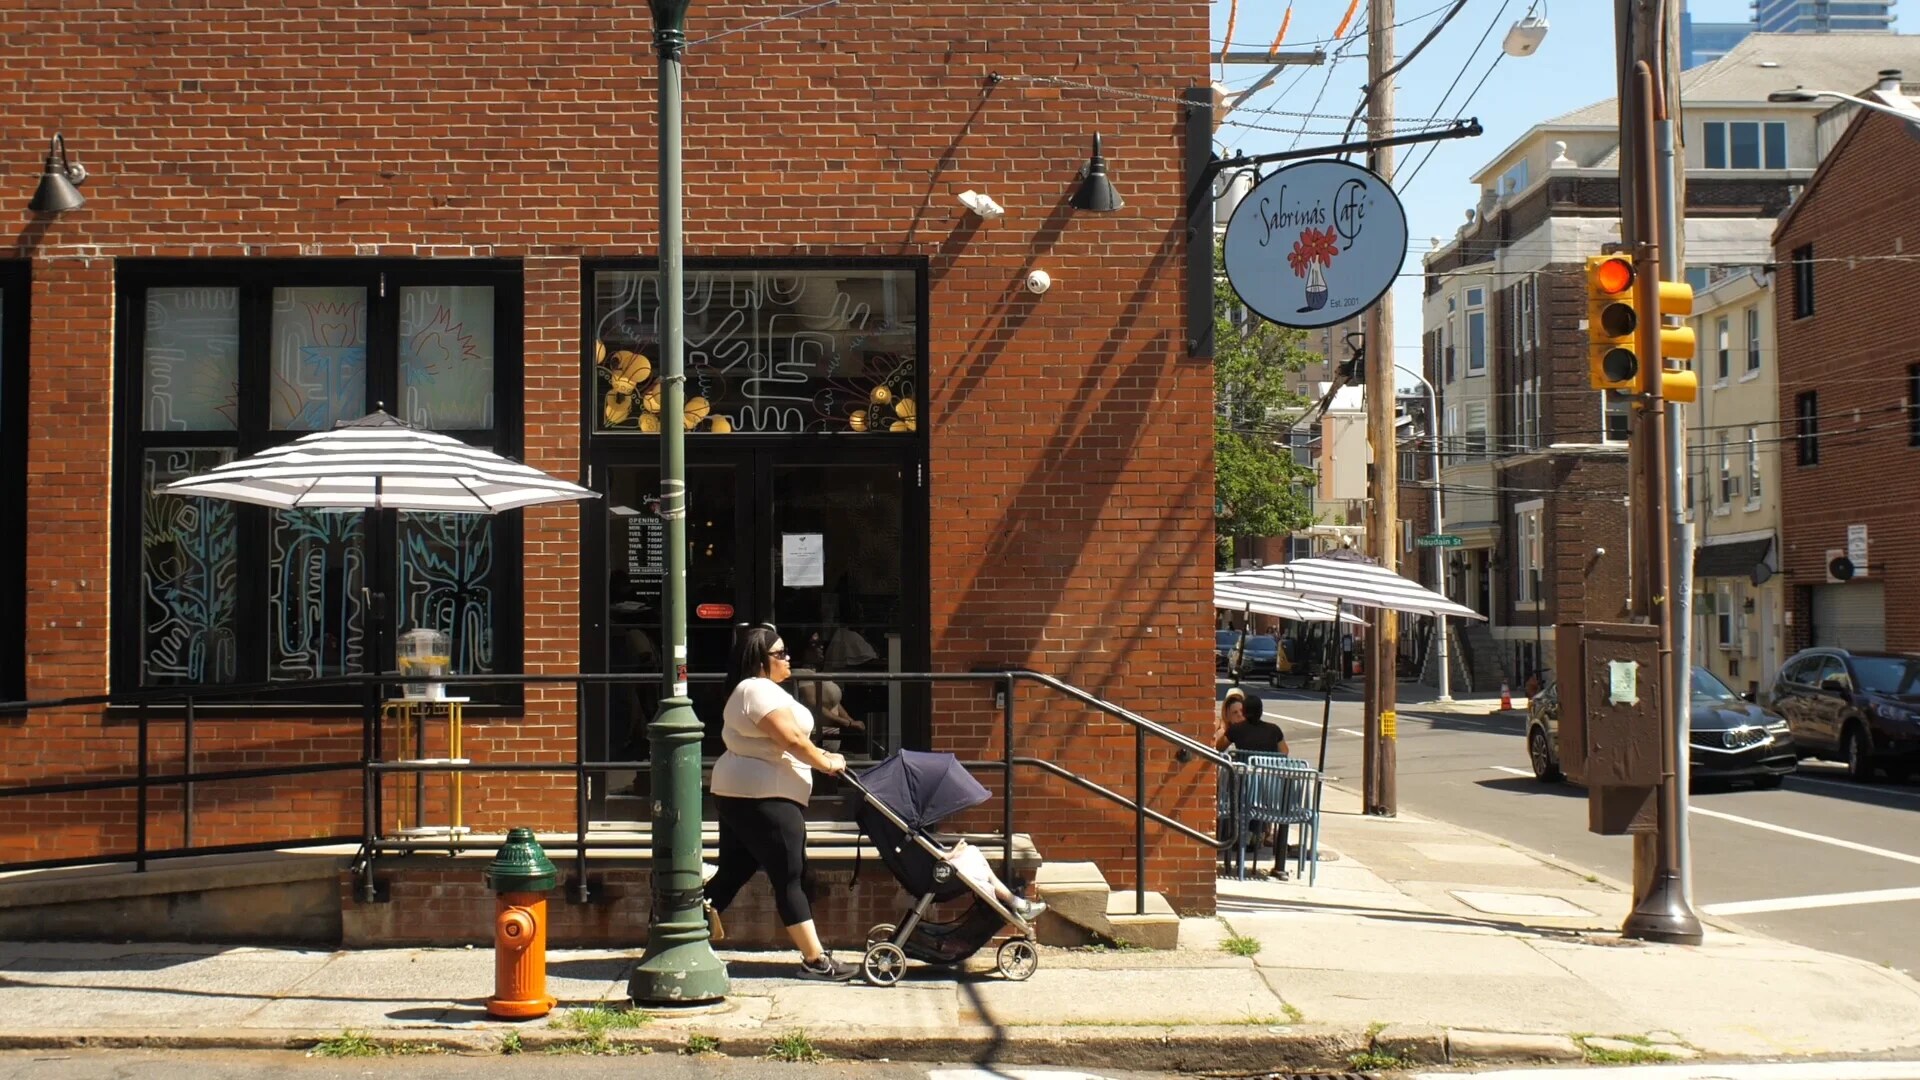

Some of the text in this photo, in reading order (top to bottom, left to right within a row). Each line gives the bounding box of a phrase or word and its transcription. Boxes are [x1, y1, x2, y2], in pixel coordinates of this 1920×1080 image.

[1259, 178, 1367, 251] Sabrina's Café
[1330, 297, 1359, 308] Est. 2001
[1417, 538, 1450, 546] Naudain
